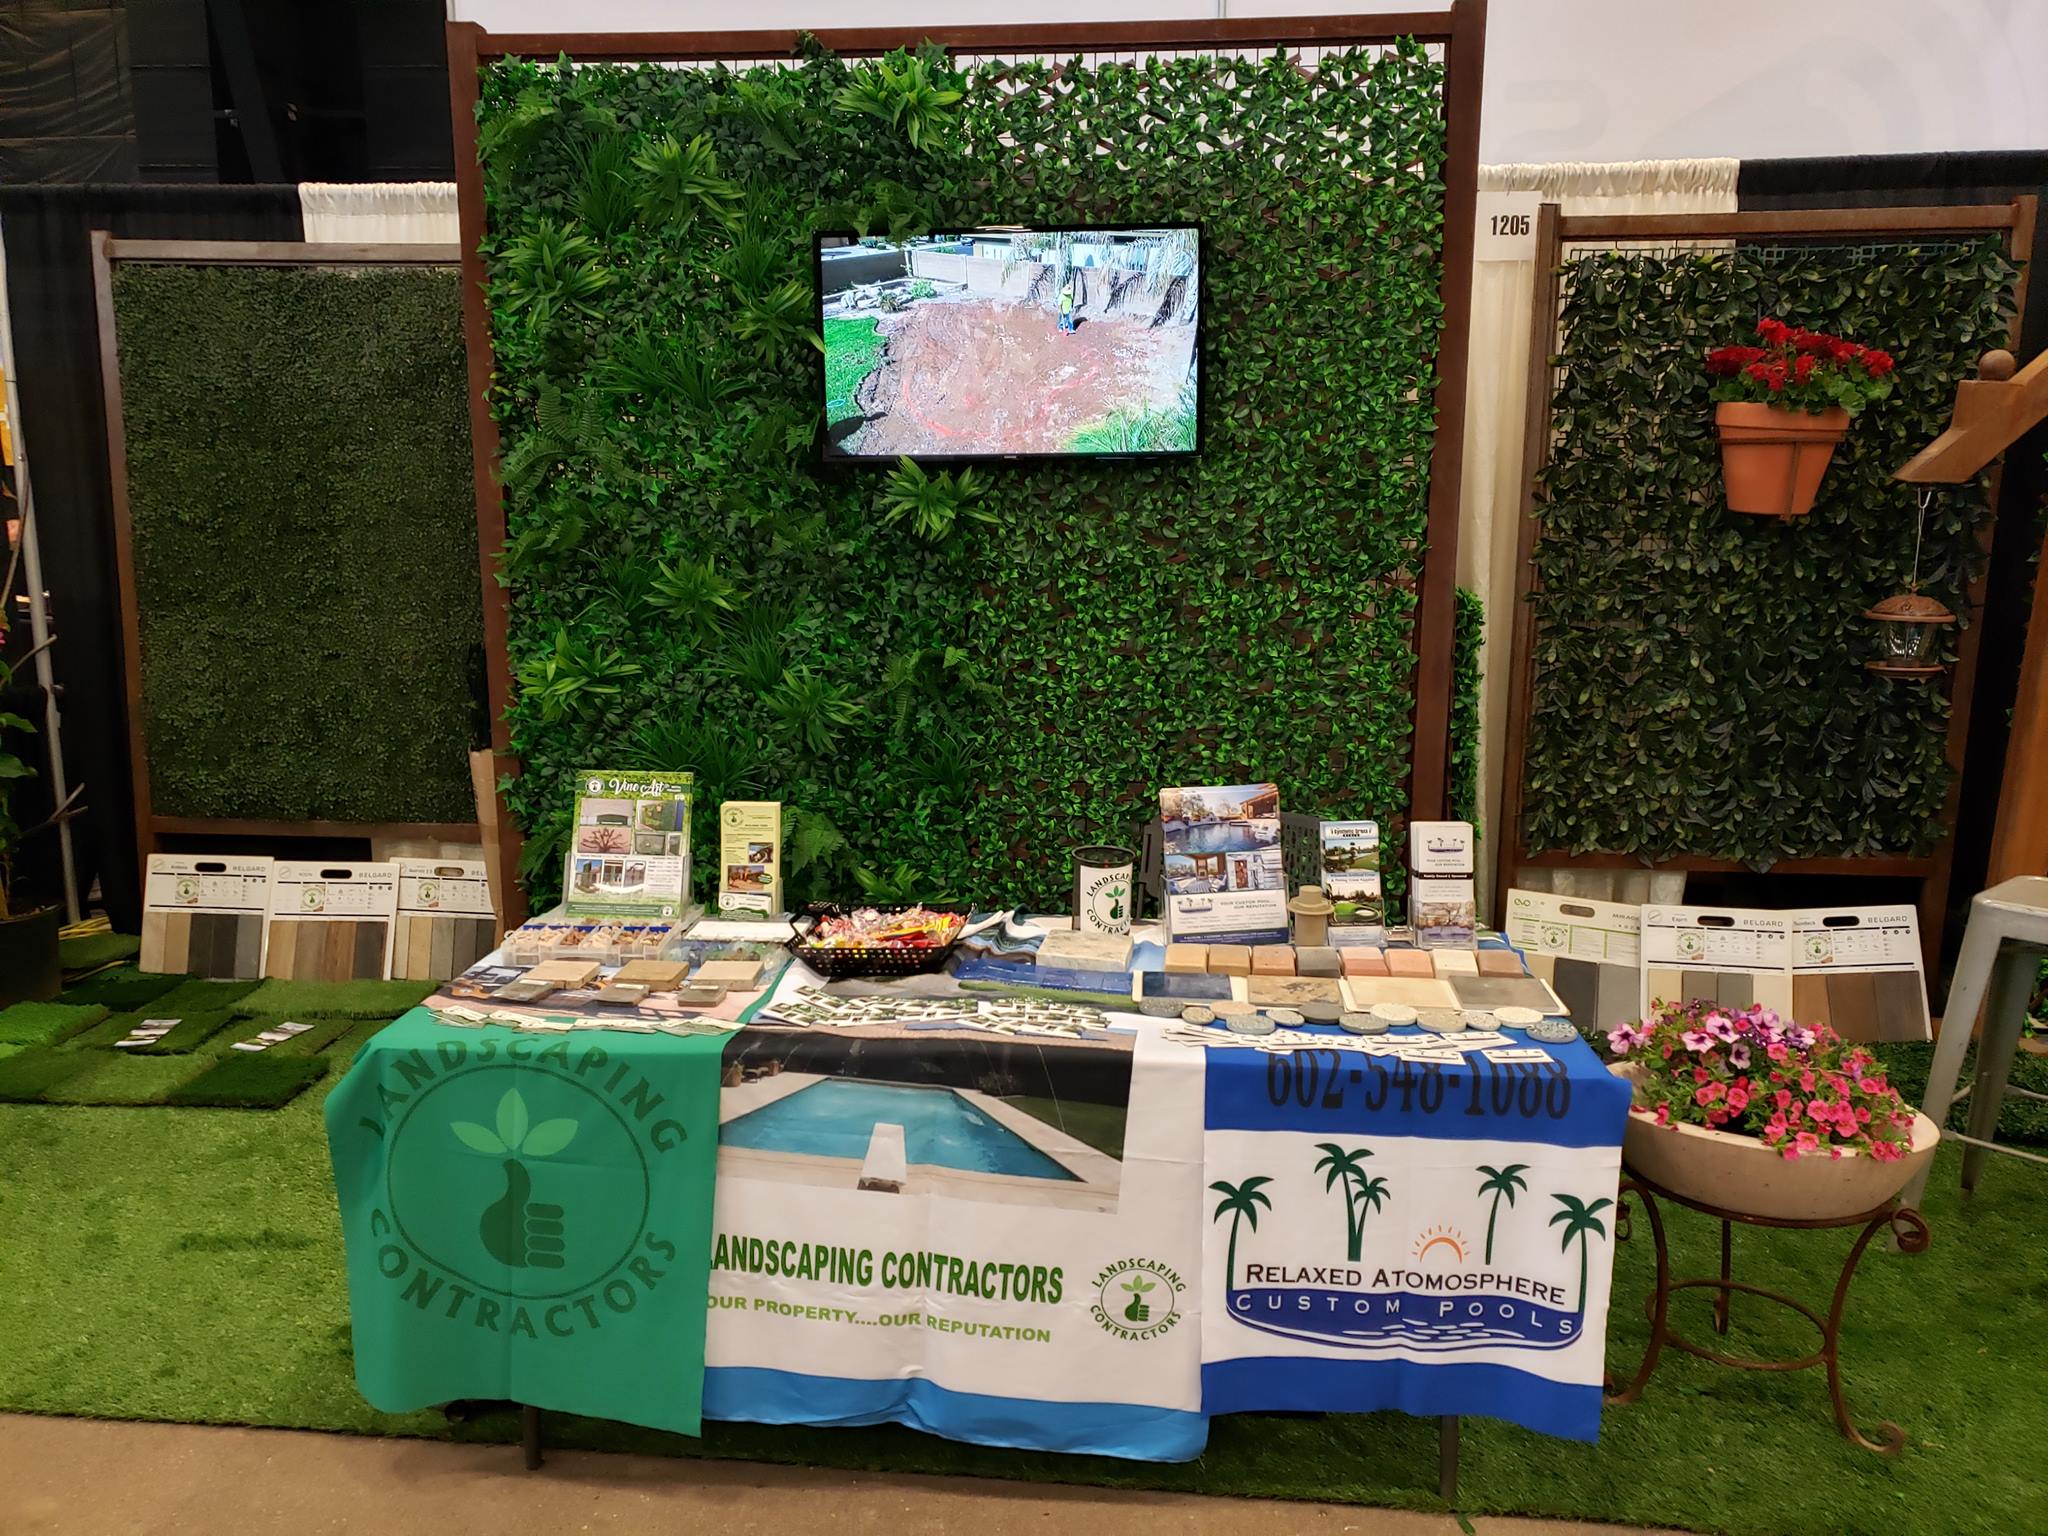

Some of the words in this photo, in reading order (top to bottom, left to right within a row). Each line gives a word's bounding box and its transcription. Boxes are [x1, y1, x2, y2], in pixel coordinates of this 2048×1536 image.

[1490, 215, 1530, 236] 1205
[609, 777, 640, 796] Vine
[1743, 919, 1784, 927] BELGARD
[1867, 915, 1908, 923] BELGARD
[358, 1038, 688, 1154] LANDSCAPING
[370, 1208, 676, 1339] CONTRACTORS
[881, 1250, 1063, 1304] CONTRACTORS
[1091, 1258, 1186, 1293] LANDSCAPING
[1246, 1264, 1362, 1287] RELAXED
[1372, 1268, 1566, 1306] ATOMOSPHERE
[926, 1313, 1051, 1343] REPUTATION
[1090, 1304, 1181, 1341] CONTRACTORS
[1236, 1294, 1401, 1316] CUSTOM
[1439, 1301, 1574, 1335] POOLS
